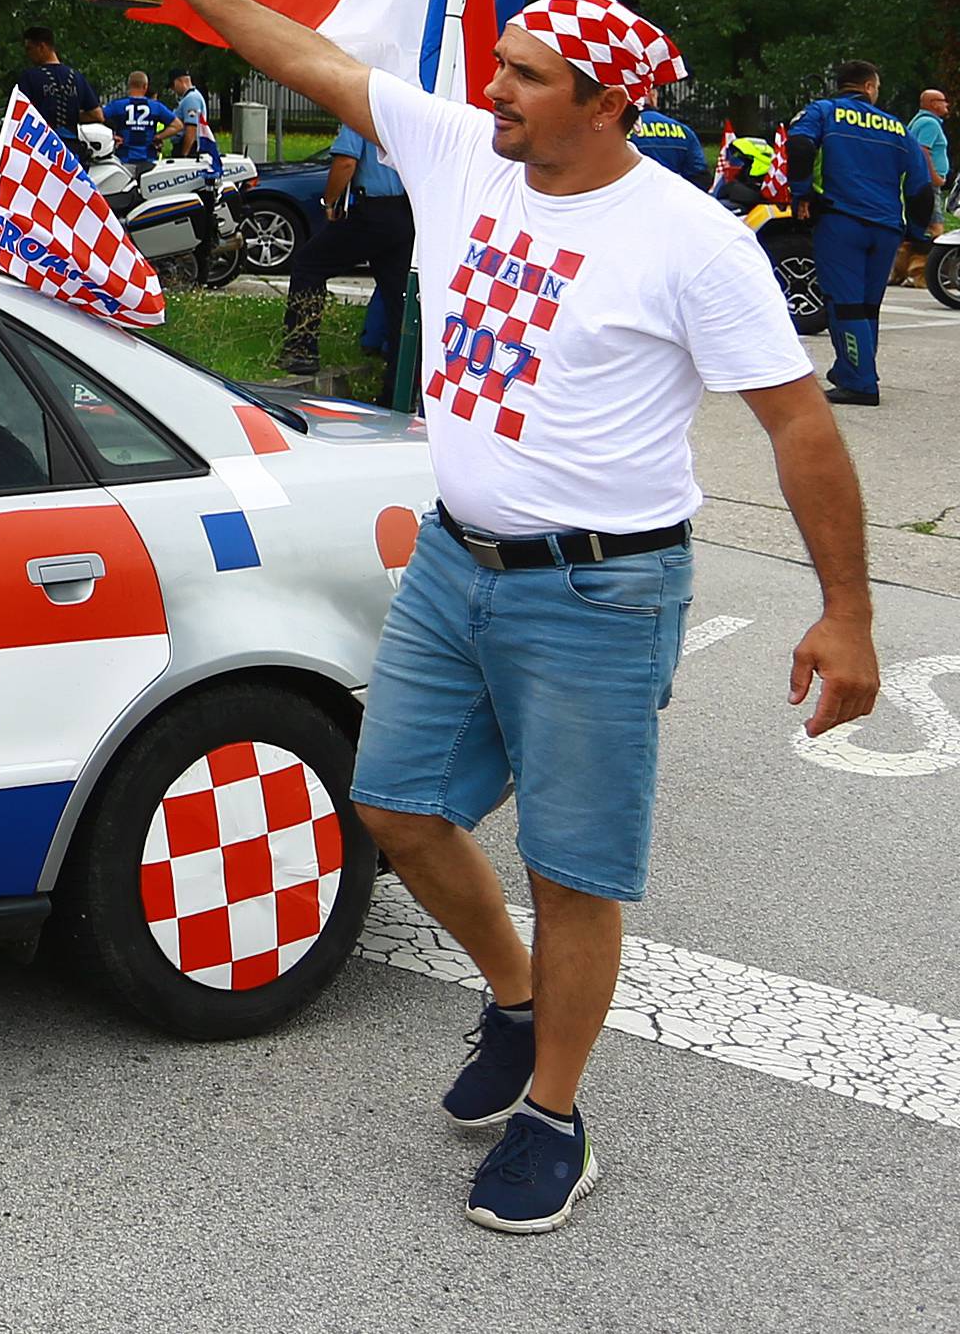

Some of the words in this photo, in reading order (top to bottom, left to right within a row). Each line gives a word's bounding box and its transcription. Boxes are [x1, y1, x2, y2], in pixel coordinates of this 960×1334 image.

[626, 122, 687, 139] OLICIJA
[835, 108, 906, 137] POLICIJA
[148, 168, 208, 193] POLICIJA
